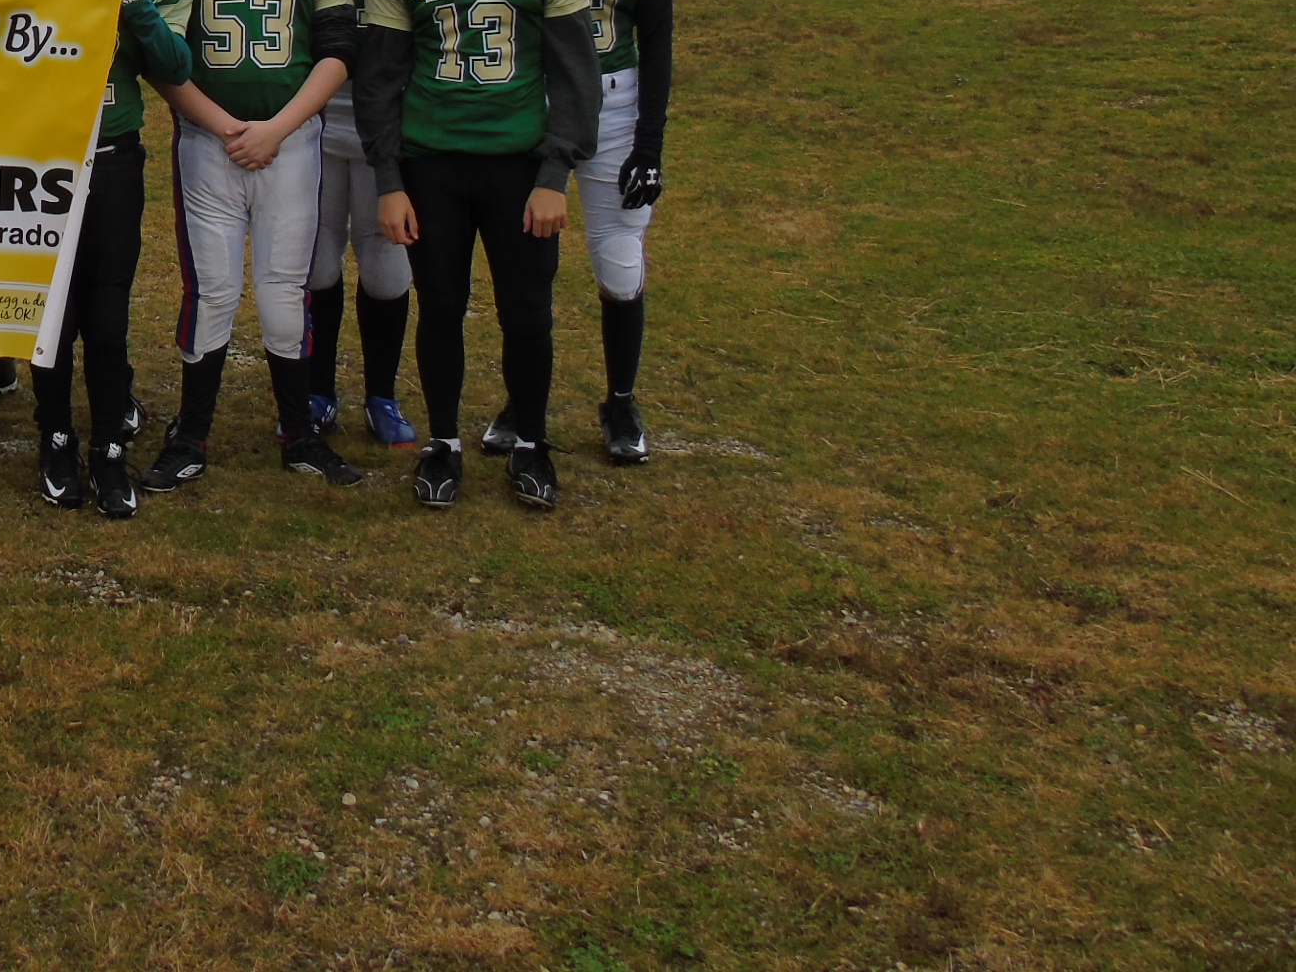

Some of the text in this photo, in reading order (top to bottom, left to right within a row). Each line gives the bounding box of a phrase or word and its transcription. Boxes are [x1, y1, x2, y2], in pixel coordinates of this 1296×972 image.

[5, 12, 79, 63] By...
[432, 0, 517, 85] 13
[0, 306, 37, 321] is OK!
[22, 296, 31, 305] a
